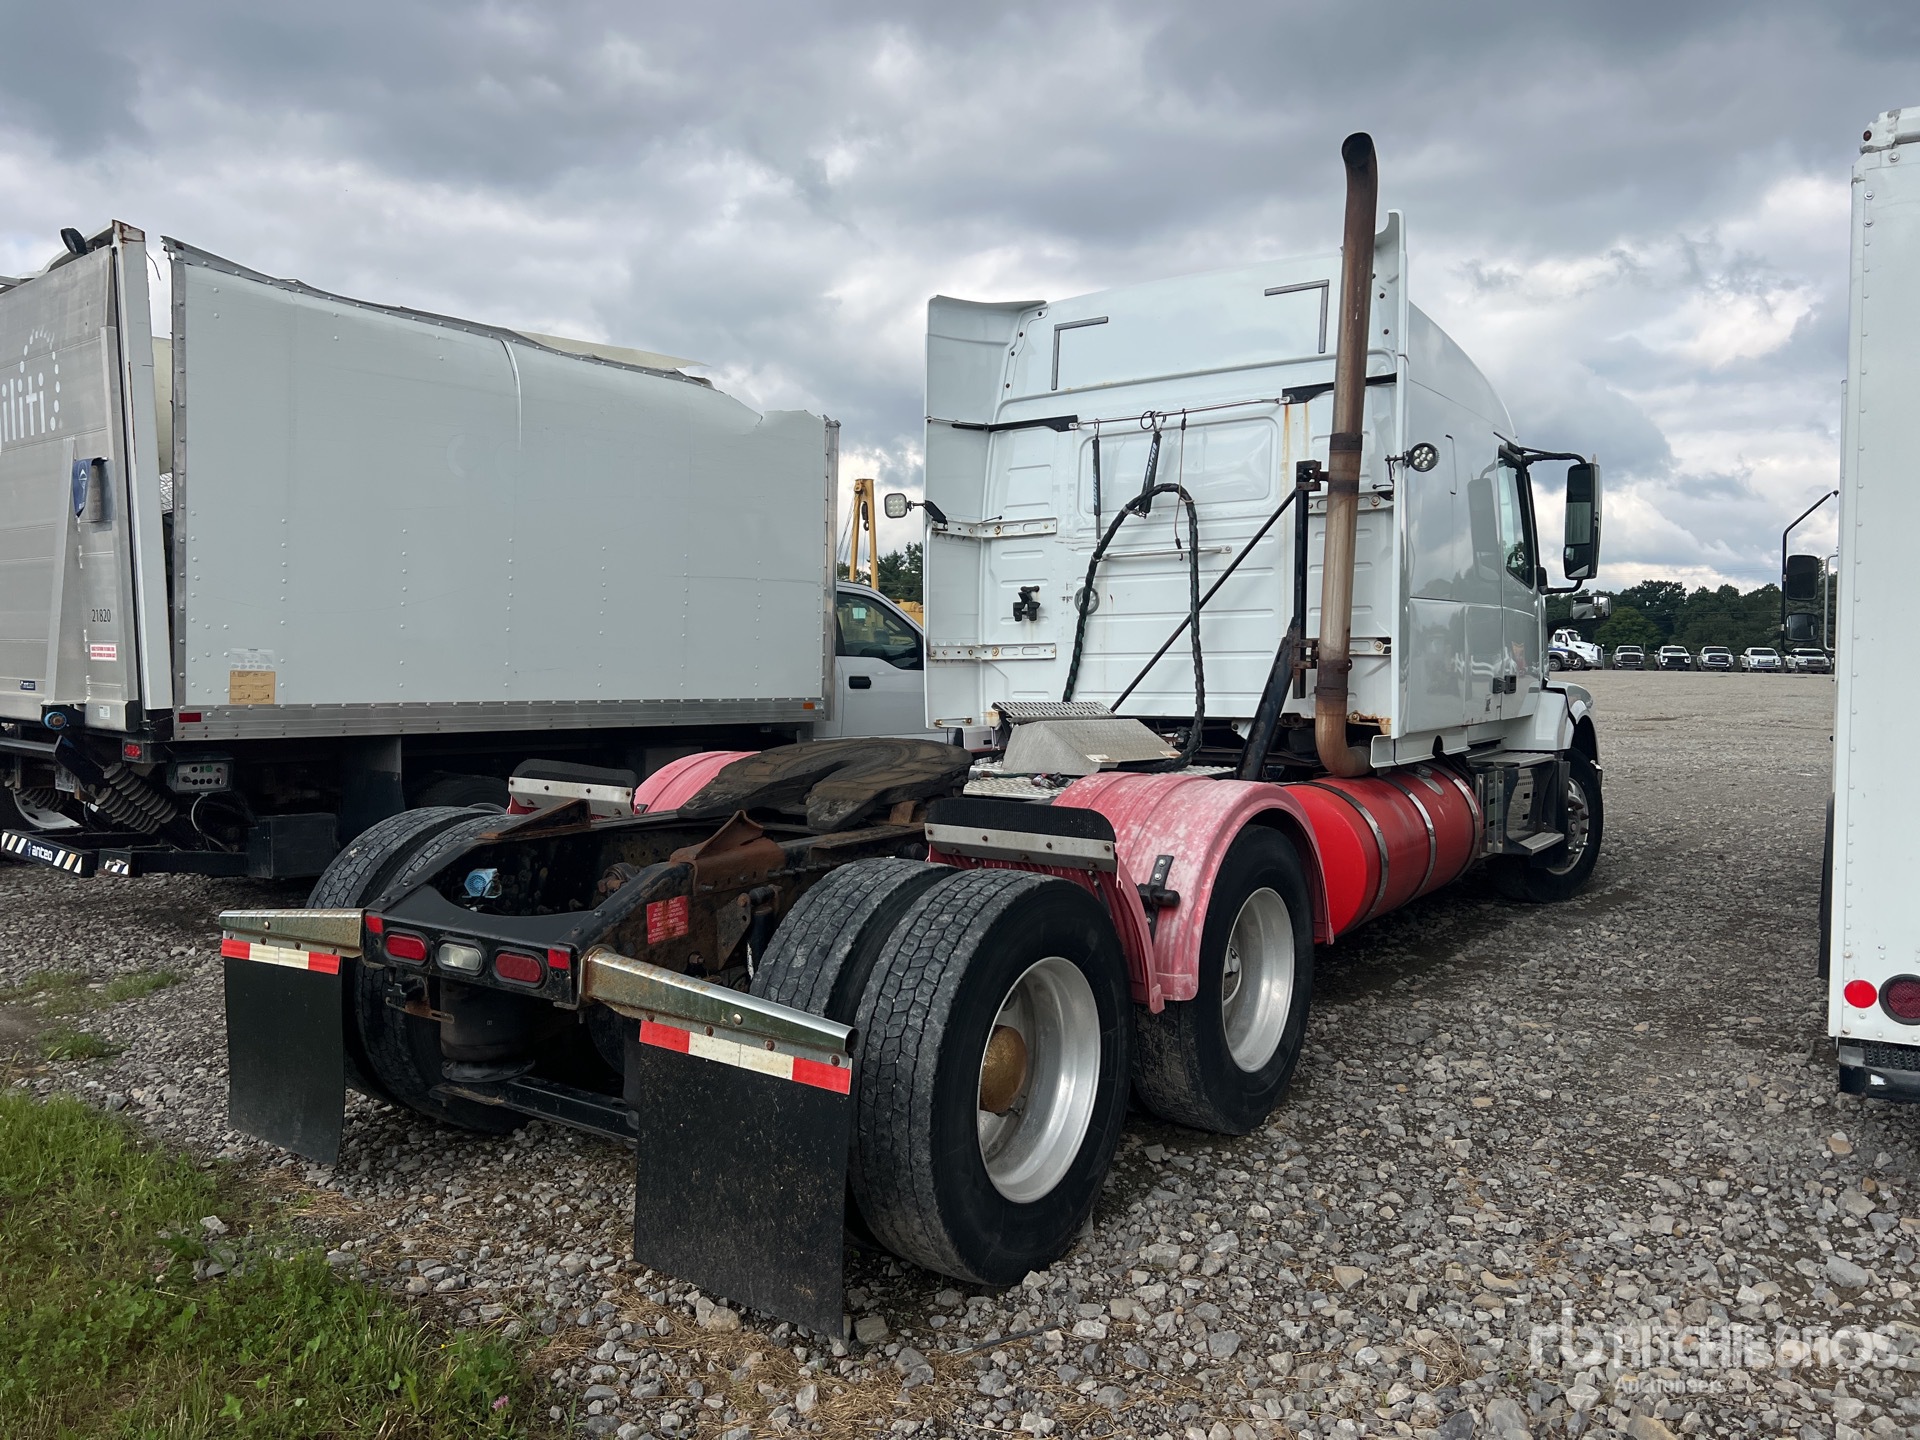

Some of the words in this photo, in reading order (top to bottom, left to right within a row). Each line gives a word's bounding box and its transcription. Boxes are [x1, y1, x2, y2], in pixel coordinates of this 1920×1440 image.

[0, 373, 46, 450] iliti
[92, 609, 111, 622] 21820
[31, 845, 53, 862] anteo
